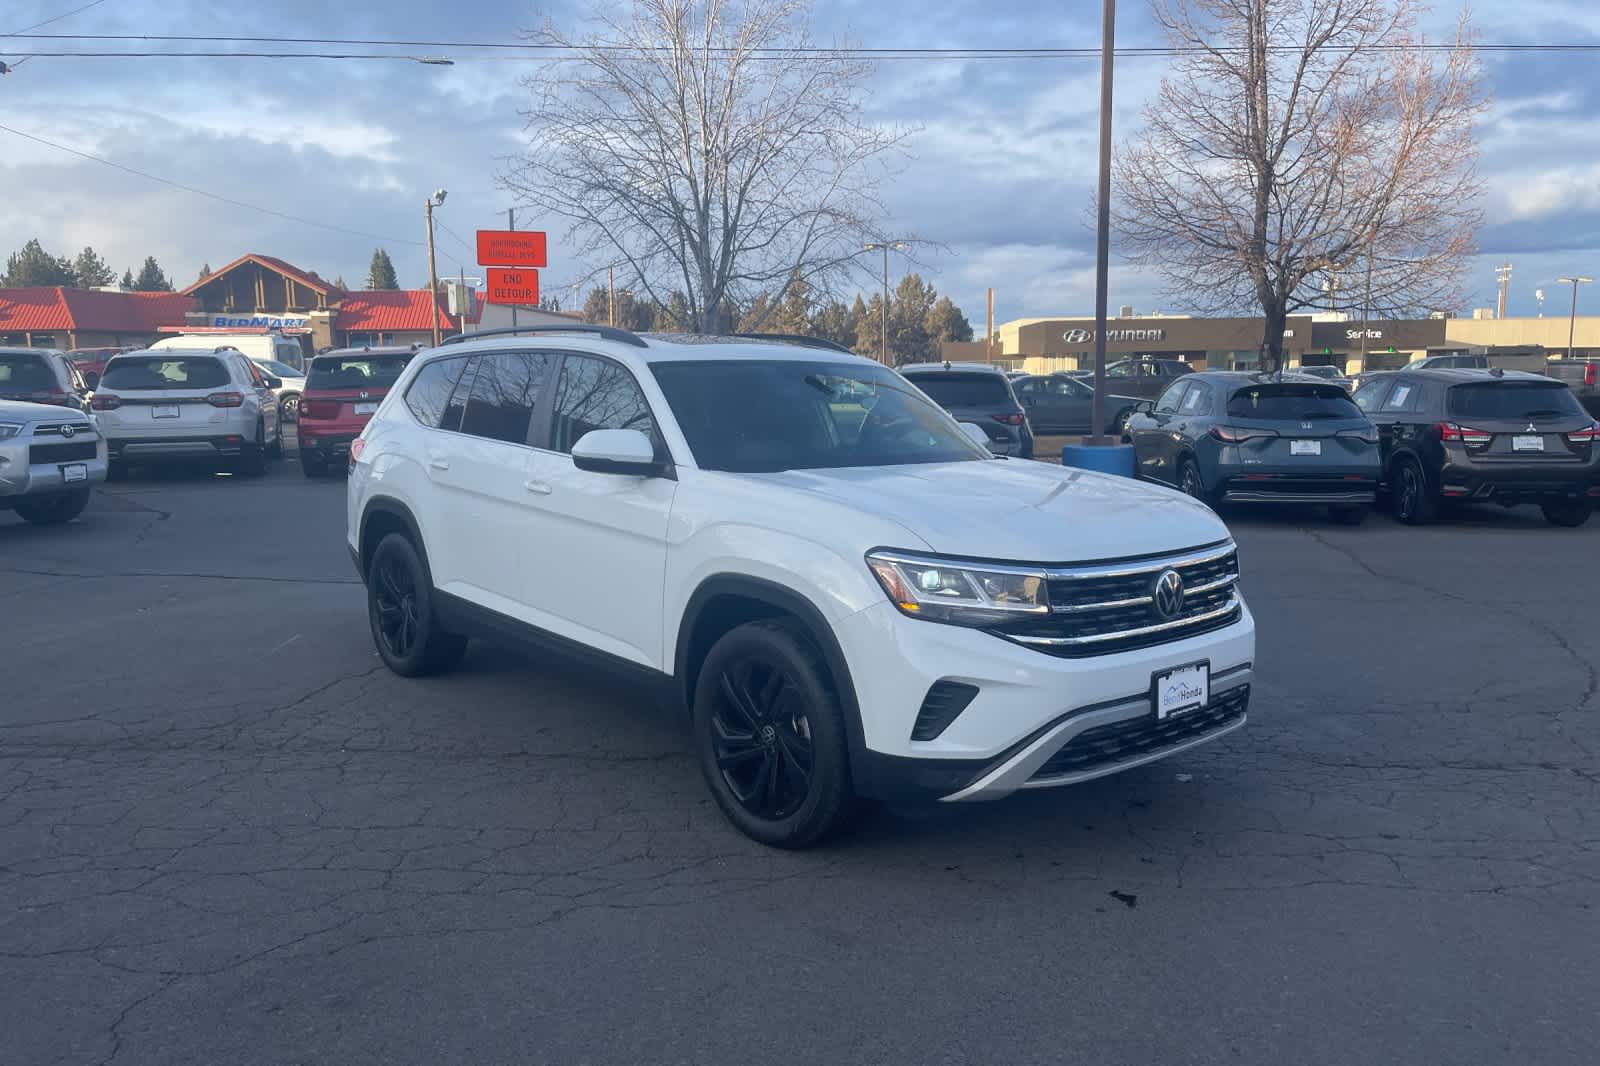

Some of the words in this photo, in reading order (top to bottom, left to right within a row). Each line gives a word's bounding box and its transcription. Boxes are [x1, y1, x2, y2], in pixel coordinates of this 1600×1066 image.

[503, 273, 522, 284] END
[494, 287, 532, 299] DETOUR
[1093, 328, 1163, 341] YUNDAI
